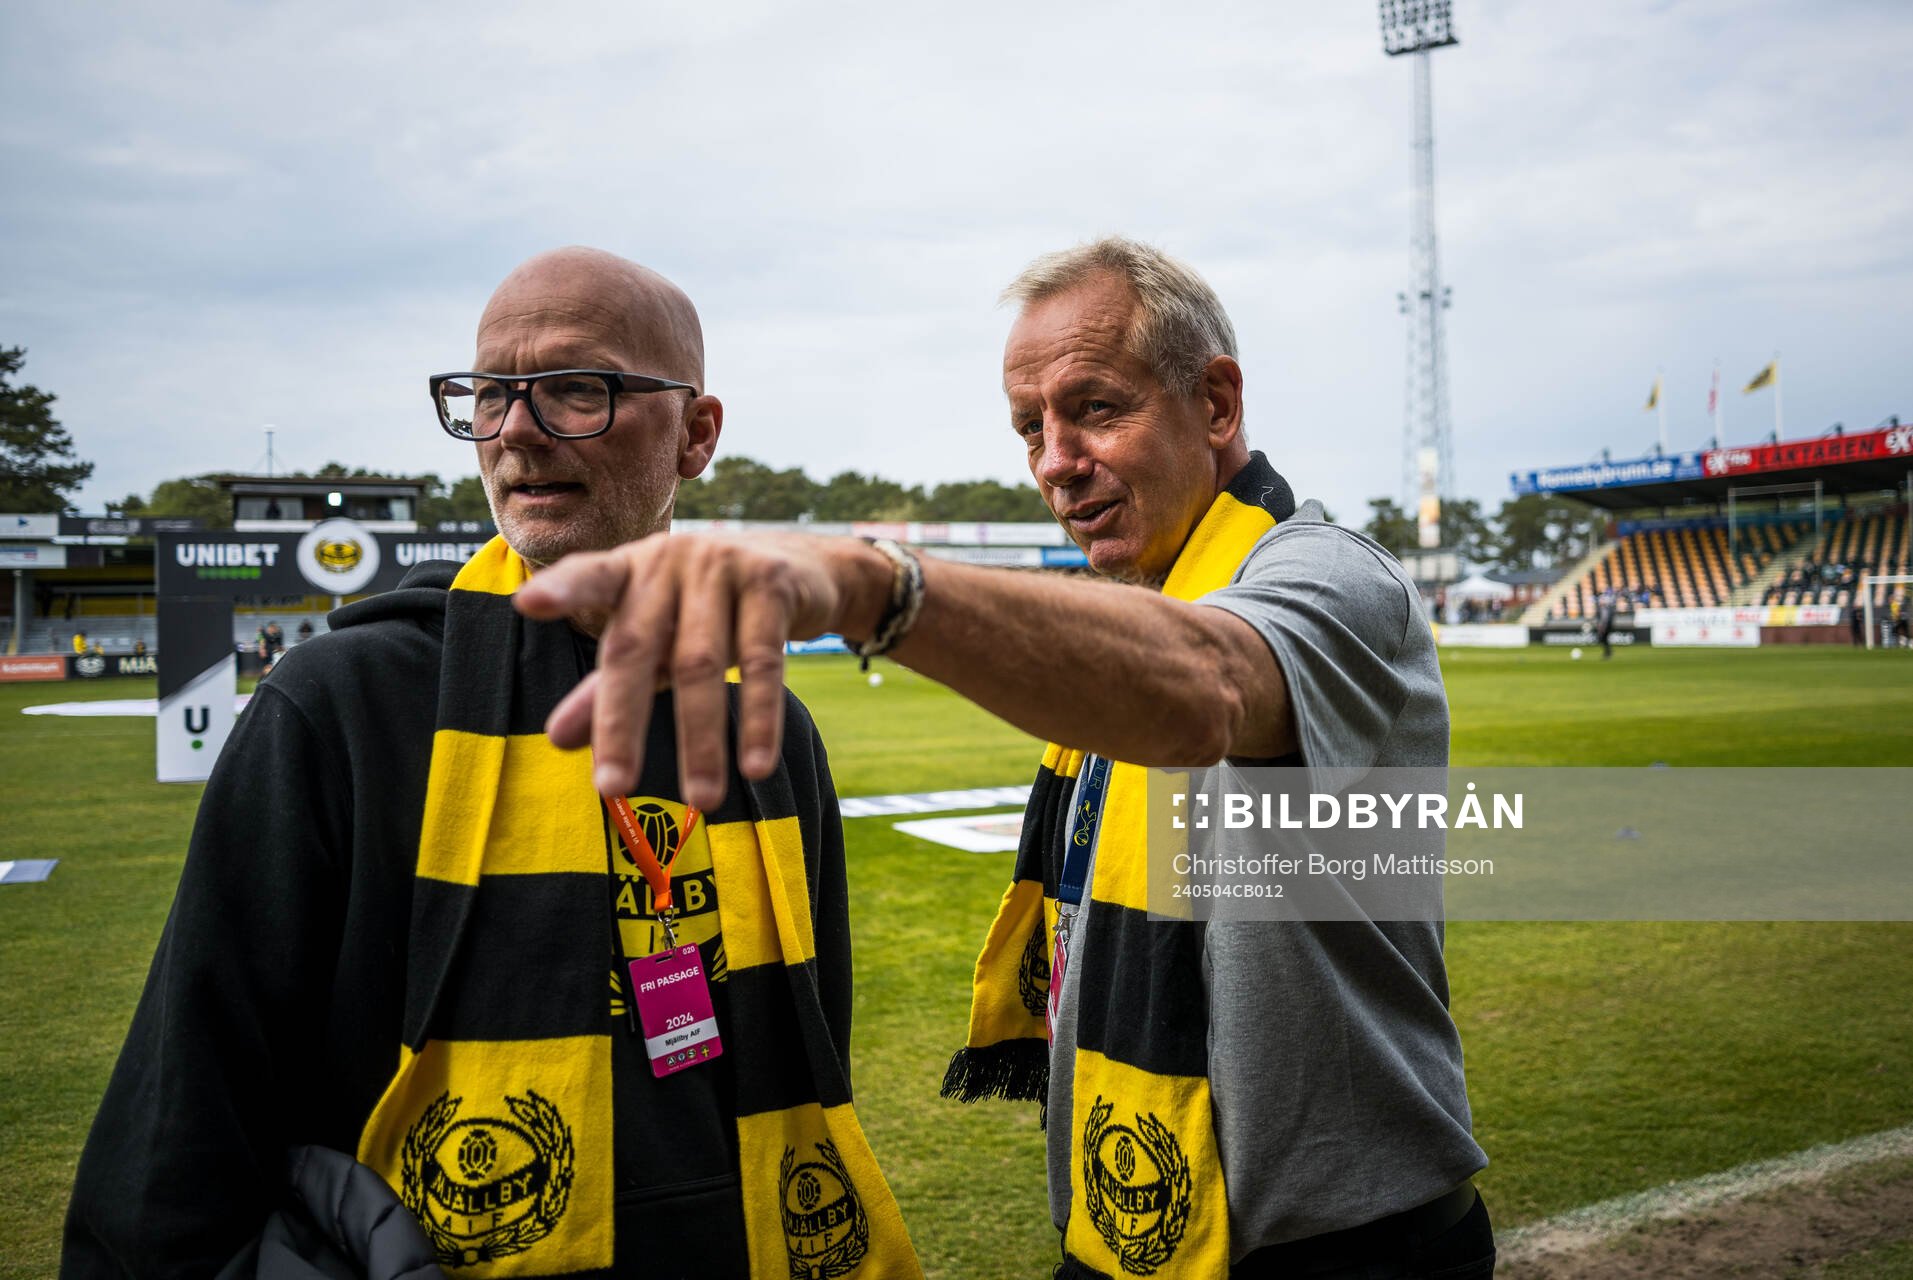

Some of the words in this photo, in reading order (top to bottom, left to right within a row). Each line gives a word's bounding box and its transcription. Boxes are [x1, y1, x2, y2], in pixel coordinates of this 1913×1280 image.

[176, 543, 280, 567] UNIBET
[396, 543, 484, 567] UNIBE
[184, 706, 210, 735] U
[640, 981, 656, 993] FRI
[656, 965, 701, 987] PASSAGE
[665, 1011, 694, 1030] 2024
[430, 1169, 533, 1214] MJÄLLBY
